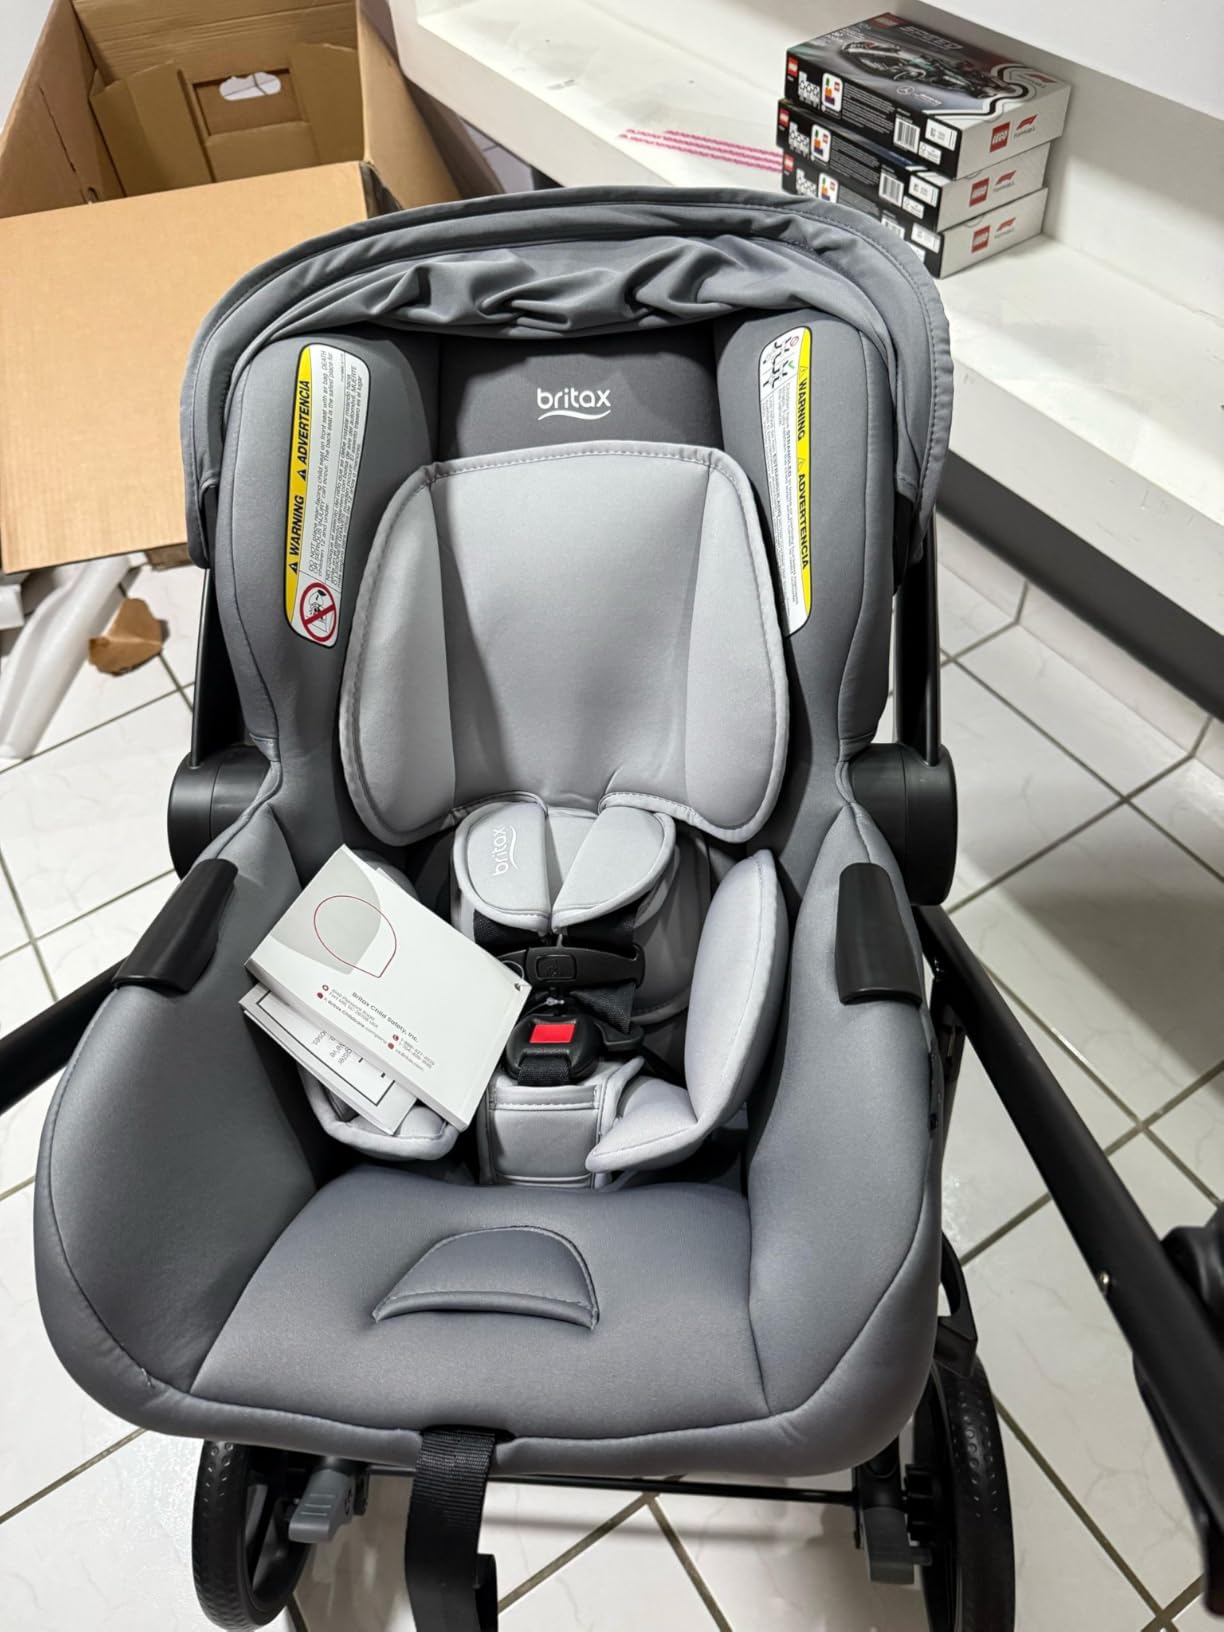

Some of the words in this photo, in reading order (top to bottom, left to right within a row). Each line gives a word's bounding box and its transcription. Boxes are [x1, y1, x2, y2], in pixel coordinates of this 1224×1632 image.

[297, 379, 310, 465] ADVERTENCIA
[536, 387, 612, 410] britax
[797, 378, 807, 441] WARNING
[289, 495, 304, 555] WARNING
[798, 473, 808, 569] ADVERTENCIA
[491, 825, 509, 876] britax
[351, 991, 370, 1007] Britax
[369, 1004, 387, 1018] Child
